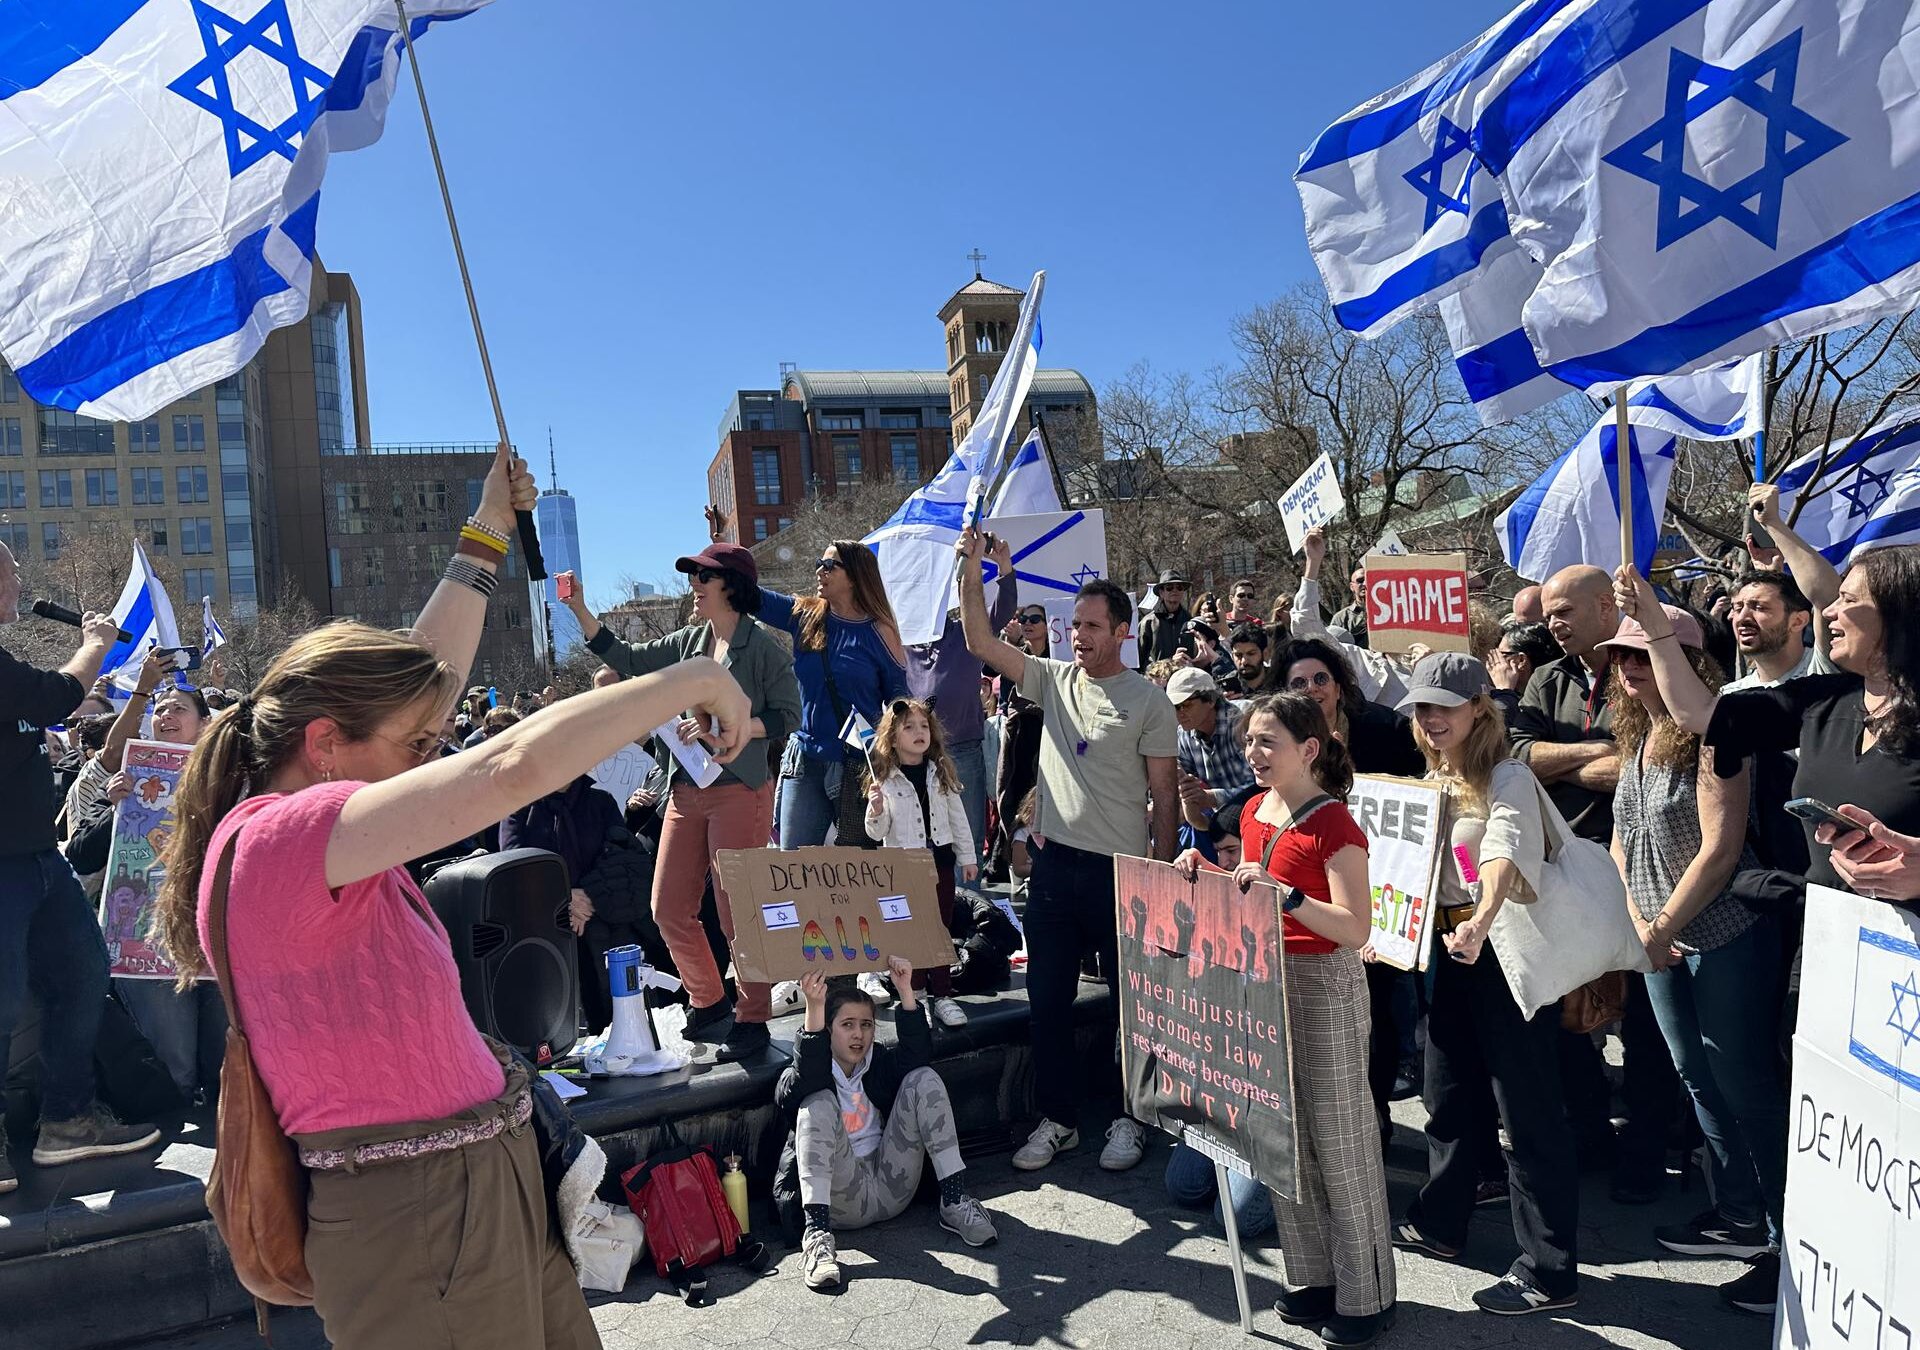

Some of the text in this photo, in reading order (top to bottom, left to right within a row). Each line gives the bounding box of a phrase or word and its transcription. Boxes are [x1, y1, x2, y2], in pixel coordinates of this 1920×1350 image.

[1282, 461, 1327, 516] DEMOCRACY
[1301, 491, 1320, 514] FOR
[1302, 505, 1326, 535] ALL
[1370, 576, 1464, 625] SHAME
[769, 860, 896, 892] DEMOCRACY
[830, 893, 850, 905] FOR
[802, 915, 881, 962] ALL
[1128, 969, 1278, 1044] When injustice
[1136, 1000, 1272, 1078] becomes law,
[1132, 1031, 1281, 1110] resistance becomes
[1161, 1070, 1240, 1130] DUTY
[1798, 1093, 1920, 1220] DEMOCR
